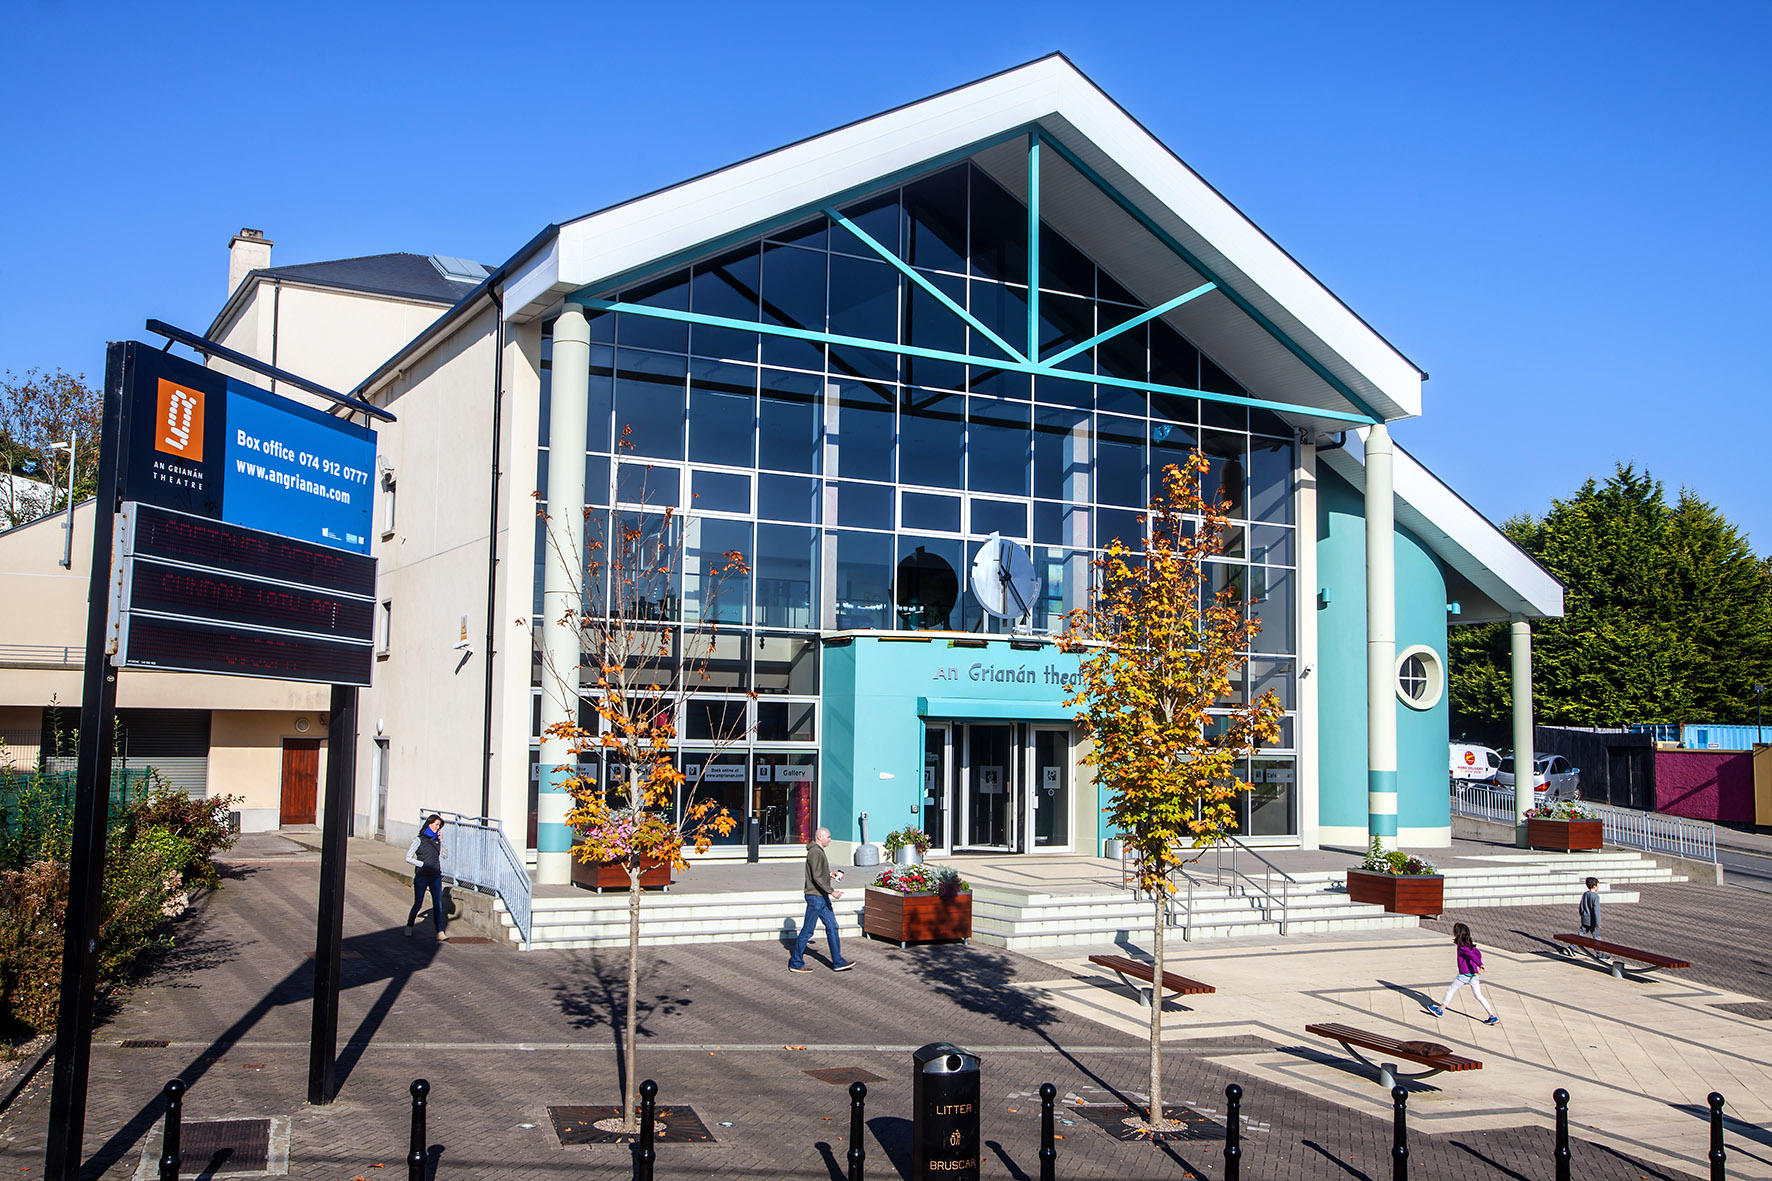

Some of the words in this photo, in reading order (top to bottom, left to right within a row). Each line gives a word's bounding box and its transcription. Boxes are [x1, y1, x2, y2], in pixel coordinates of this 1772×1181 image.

[237, 429, 261, 452] Box
[263, 440, 295, 463] office
[299, 452, 320, 471] 074
[322, 459, 341, 477] 912
[343, 466, 369, 486] 0777
[153, 460, 166, 470] AN
[167, 464, 204, 480] GRIANÁN
[152, 471, 203, 491] THEATRE
[236, 459, 351, 505] www.angrianan.com
[968, 662, 1037, 684] Grianán
[782, 768, 806, 778] Gallery
[936, 1104, 972, 1115] LITTER
[929, 1158, 976, 1170] BRUSCAR
